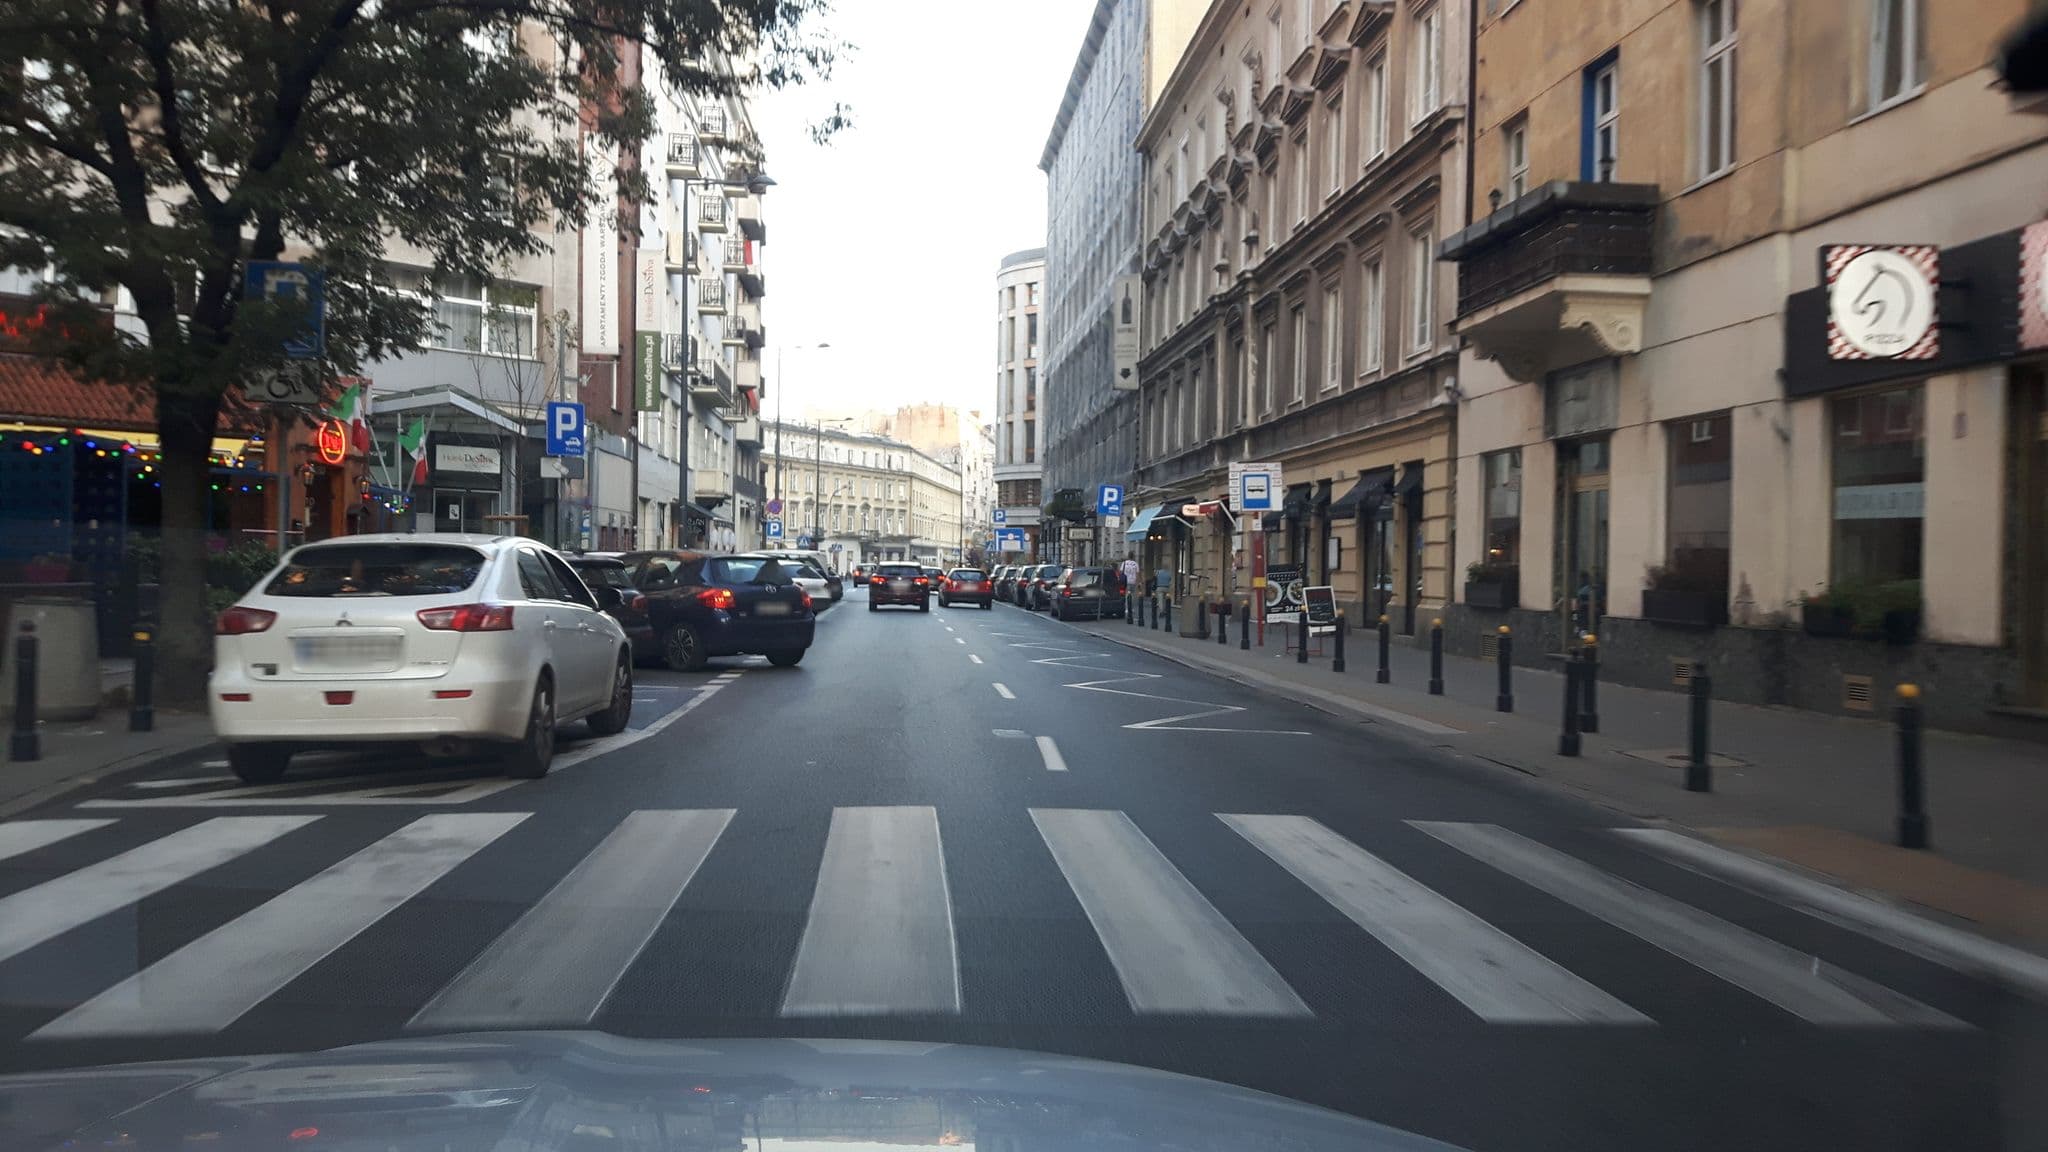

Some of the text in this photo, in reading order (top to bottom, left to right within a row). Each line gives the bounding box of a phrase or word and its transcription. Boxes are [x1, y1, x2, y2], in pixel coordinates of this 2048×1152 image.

[643, 335, 655, 407] www.desilva.pl
[555, 407, 577, 440] P
[1103, 487, 1118, 507] P
[995, 511, 1004, 521] P
[770, 523, 779, 535] P
